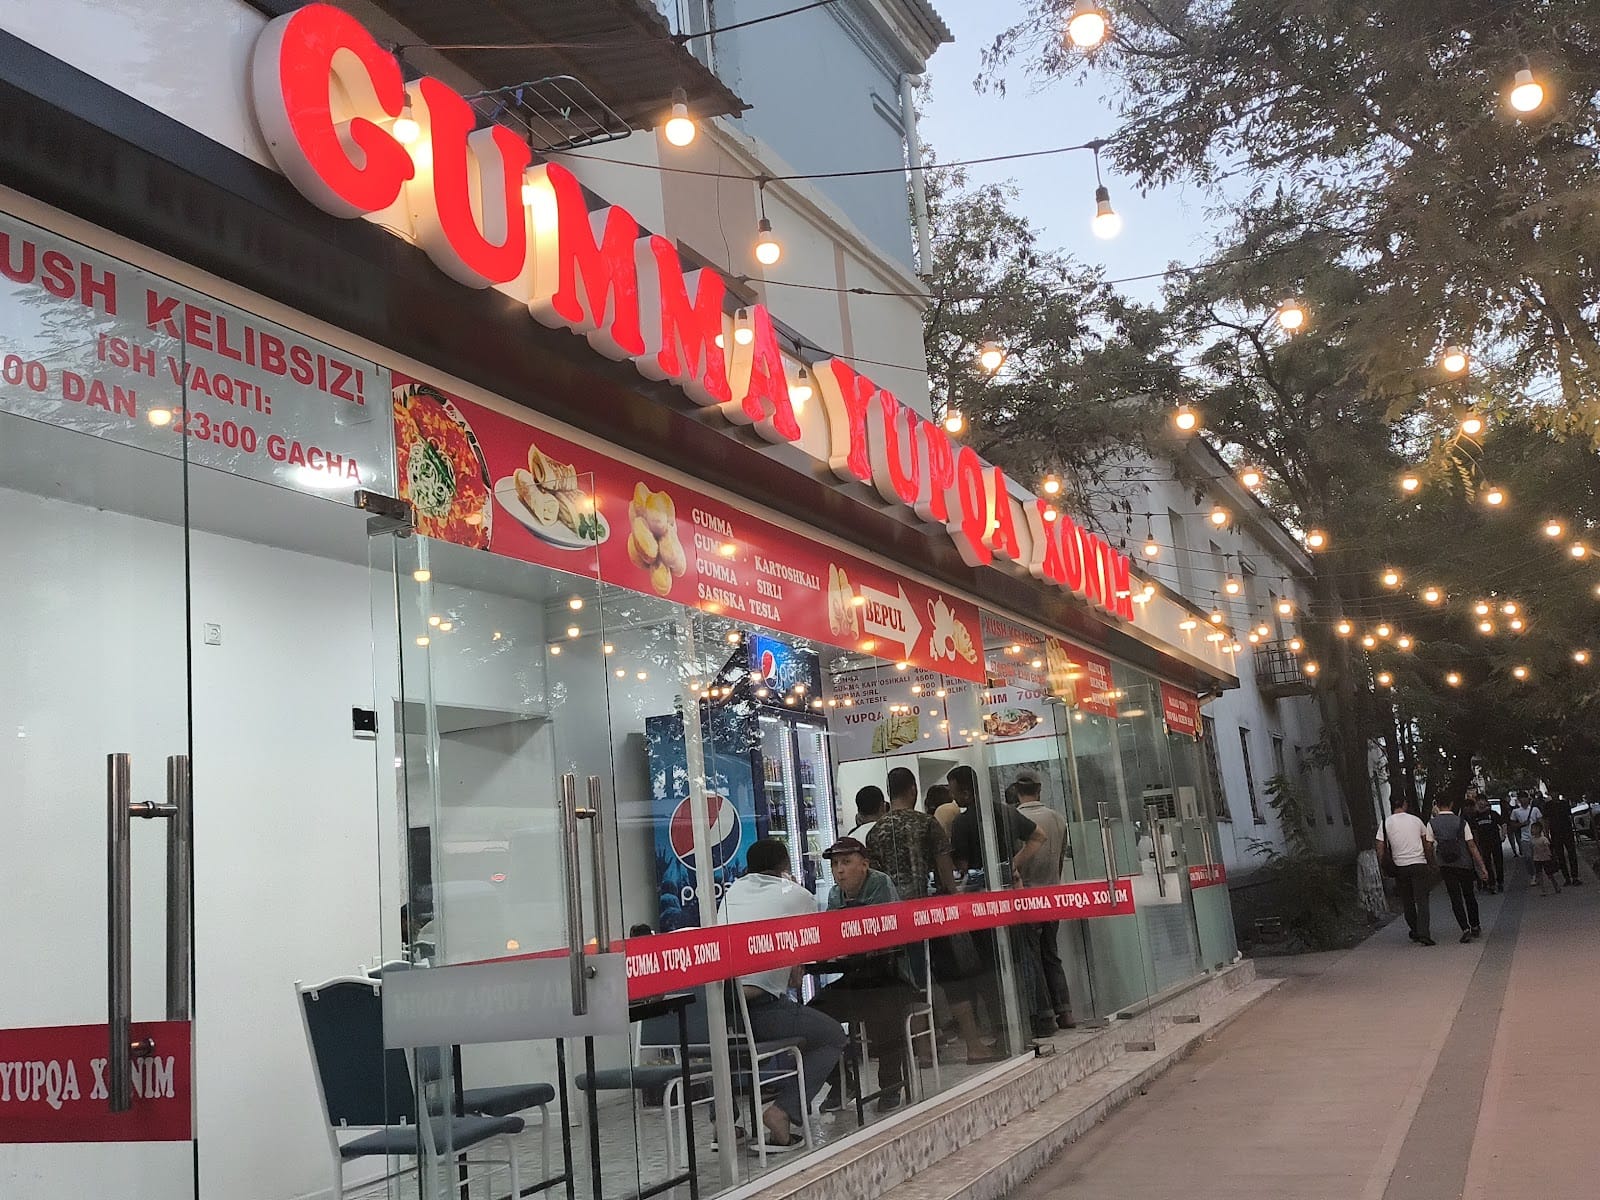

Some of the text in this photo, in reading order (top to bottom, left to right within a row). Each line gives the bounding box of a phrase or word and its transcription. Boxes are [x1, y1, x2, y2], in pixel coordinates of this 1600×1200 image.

[276, 3, 801, 444] GUMMA
[828, 357, 1021, 567] YUPQA
[146, 289, 366, 406] KELIBSIZ!
[97, 332, 273, 416] ISH VAQTI:
[62, 370, 137, 418] DAN
[172, 405, 257, 454] 23:00
[266, 434, 363, 485] GACHA
[691, 508, 734, 538] GUMMA
[693, 533, 821, 591] GUMA KARTOSHKALI
[695, 558, 783, 600] GUMMA SIRLI
[697, 583, 746, 612] SASISKA
[865, 599, 906, 634] BEPUL
[844, 711, 884, 725] YUPQA
[1014, 895, 1052, 912] GUMMA
[1054, 891, 1091, 909] YUPQA
[625, 941, 721, 979] GUMMA YUPQA XONIM
[748, 926, 821, 956] GUMMA YUPQA XONIM
[0, 1055, 175, 1110] YUPQA XNIM
